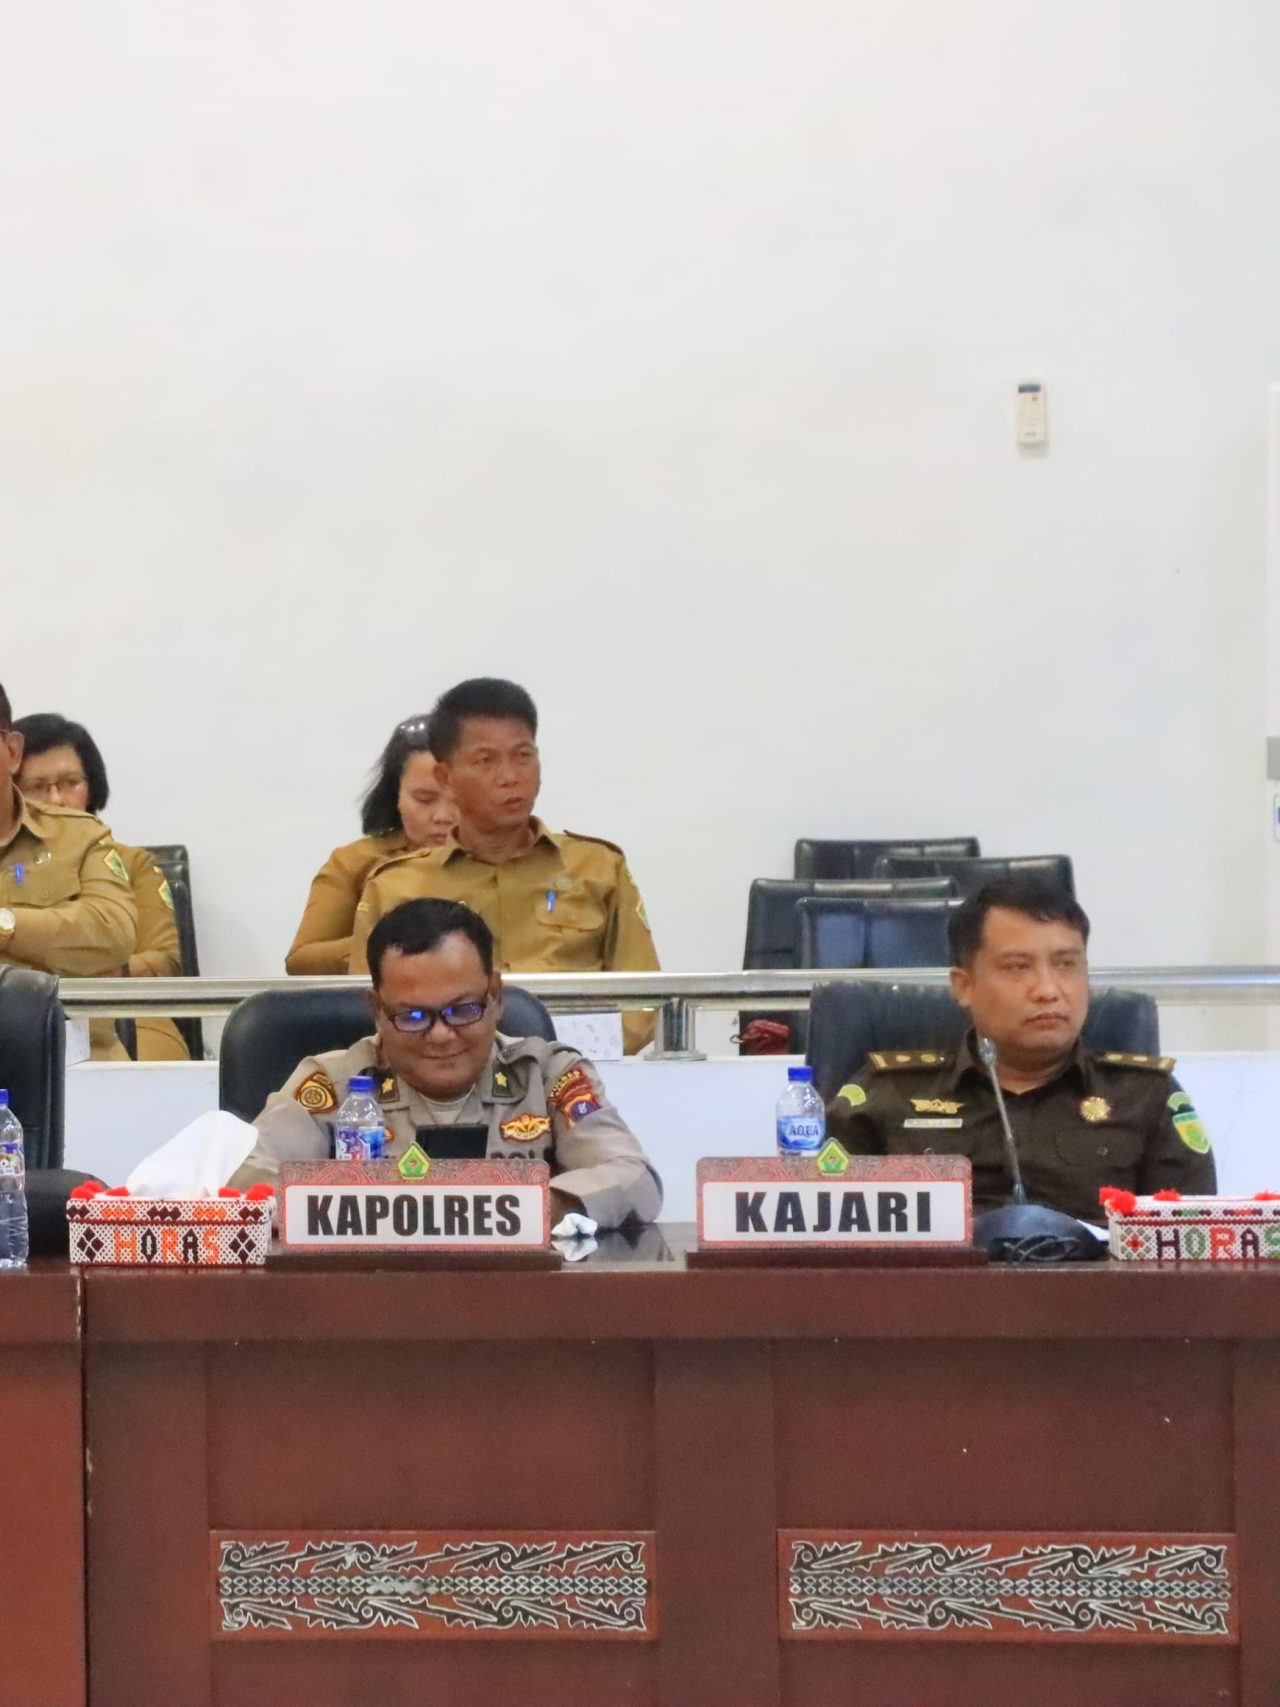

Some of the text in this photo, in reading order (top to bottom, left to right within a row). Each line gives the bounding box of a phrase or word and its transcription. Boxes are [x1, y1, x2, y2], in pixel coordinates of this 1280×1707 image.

[549, 1070, 581, 1098] POLRES
[788, 1125, 819, 1138] AQUA
[307, 1194, 521, 1237] KAPOLRES
[735, 1191, 931, 1233] KAJARI
[113, 1227, 220, 1265] HORAS
[1154, 1226, 1280, 1261] HORAS
